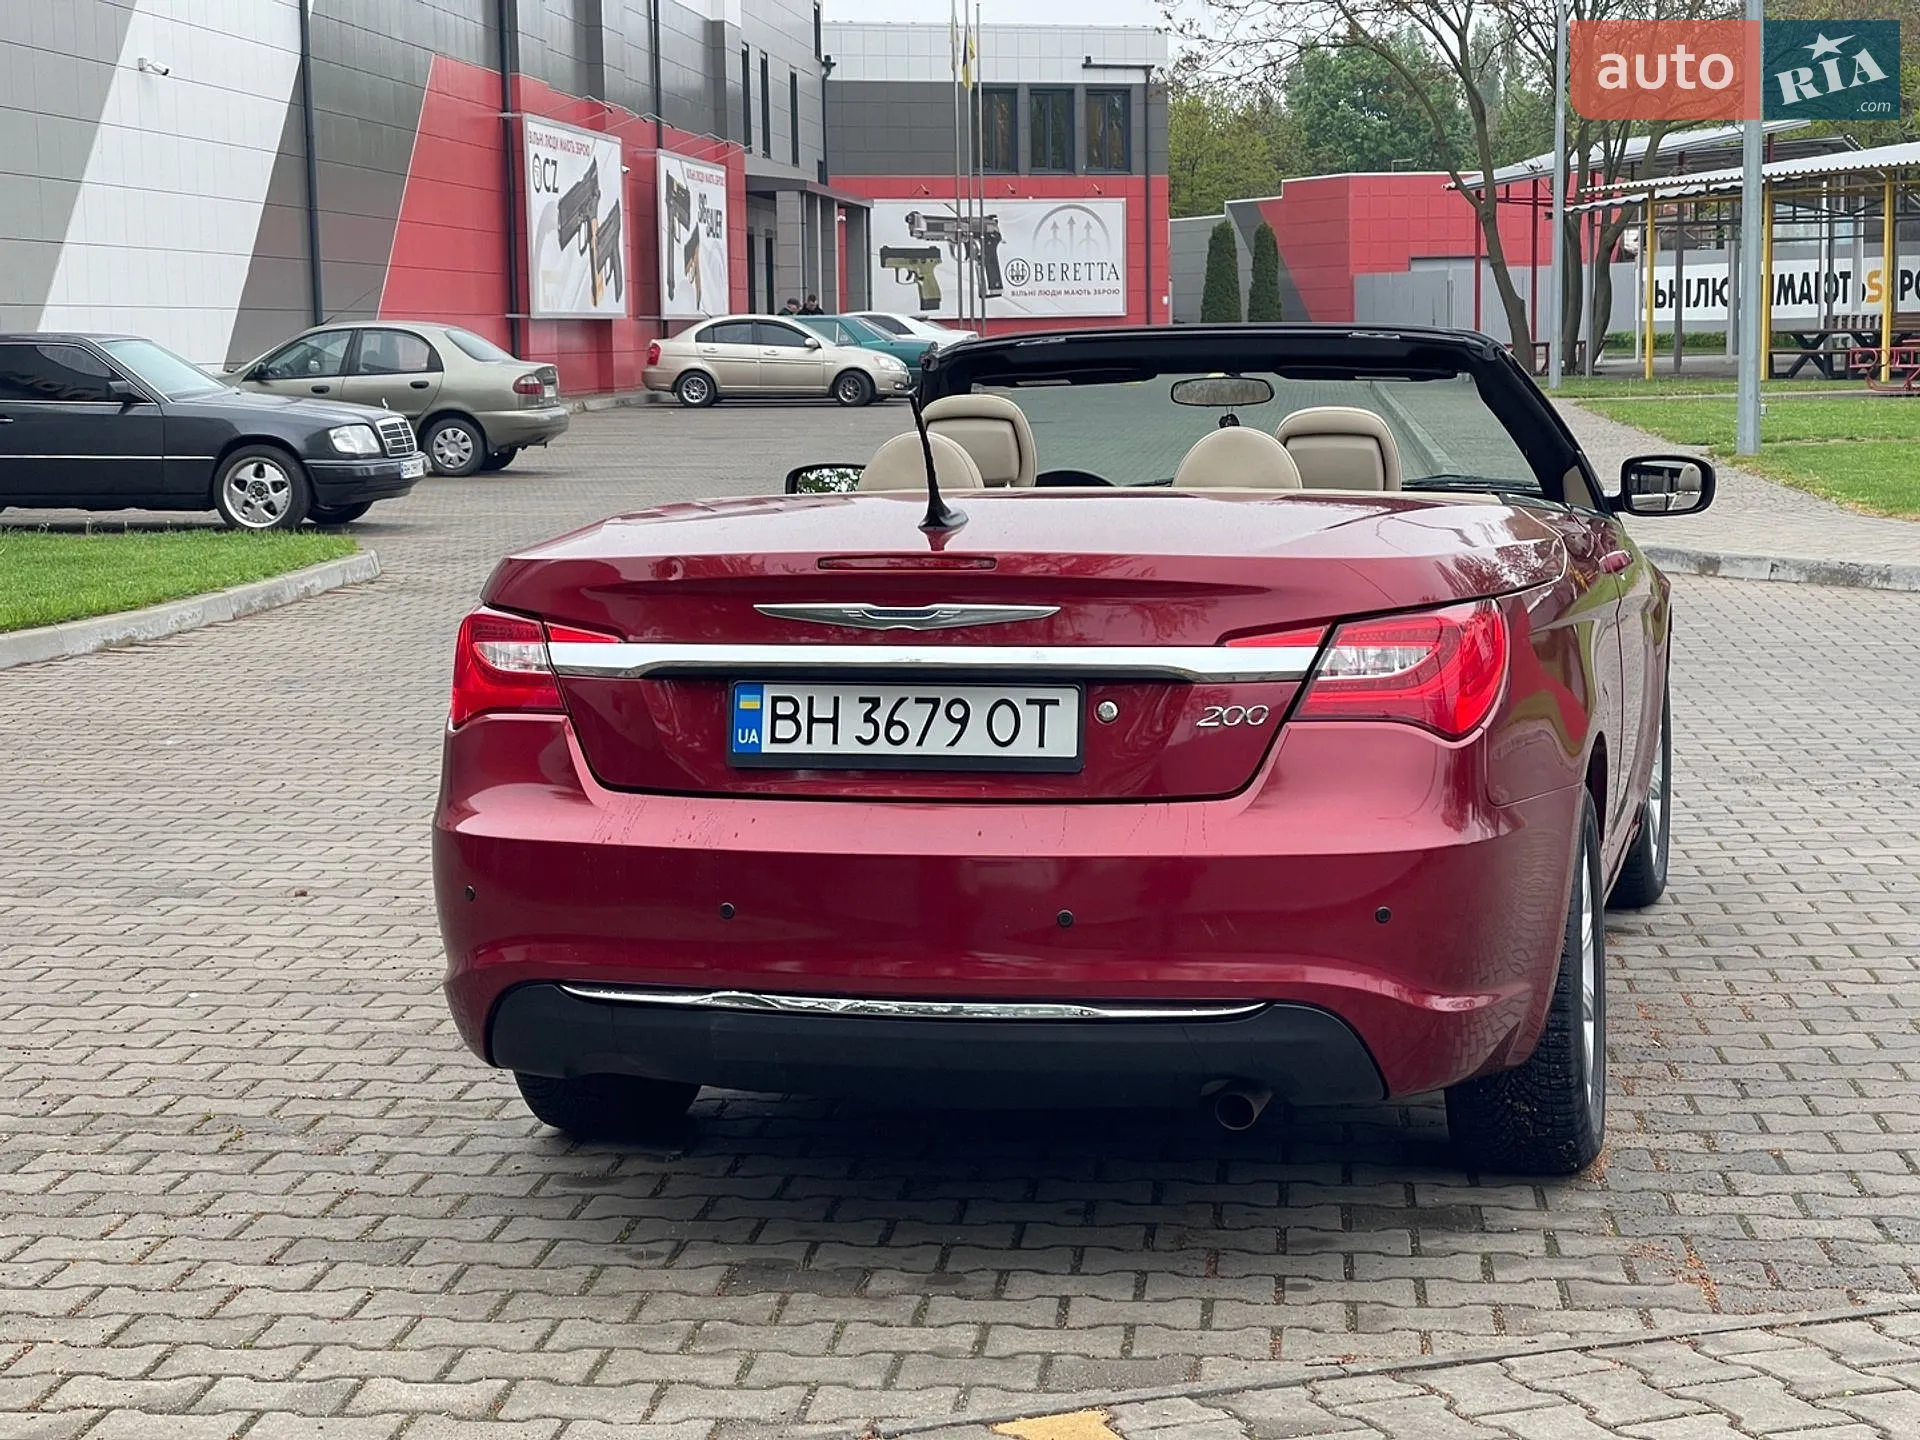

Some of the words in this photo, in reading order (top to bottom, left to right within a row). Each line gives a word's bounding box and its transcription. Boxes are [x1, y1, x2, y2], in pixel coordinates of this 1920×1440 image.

[543, 158, 559, 193] CZ
[1034, 262, 1120, 282] BERETTA
[1037, 289, 1062, 298] ЛЮДИ
[1063, 288, 1091, 297] МАЮТЬ
[1093, 288, 1120, 296] ЗБРОЮ
[769, 695, 841, 745] BH
[855, 696, 971, 748] 3679
[986, 698, 1060, 748] OT
[1196, 705, 1269, 727] 200
[738, 728, 760, 744] UA
